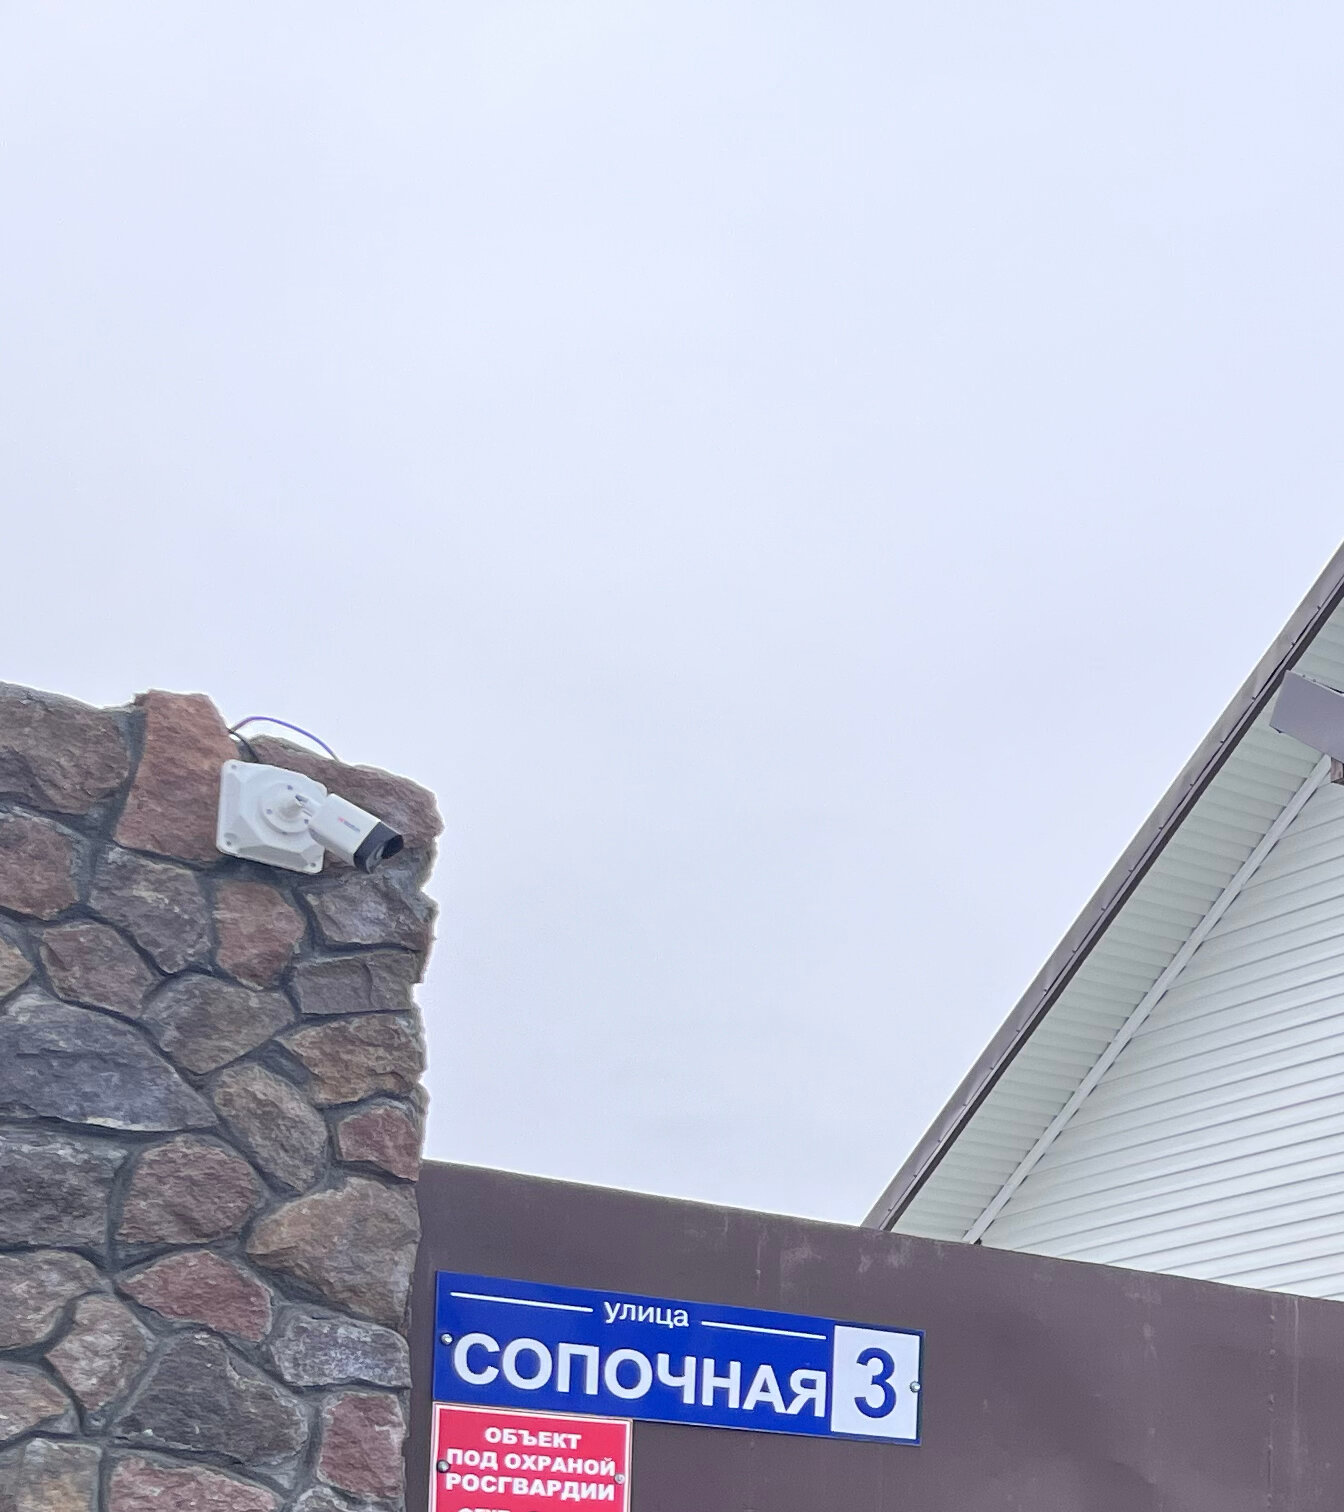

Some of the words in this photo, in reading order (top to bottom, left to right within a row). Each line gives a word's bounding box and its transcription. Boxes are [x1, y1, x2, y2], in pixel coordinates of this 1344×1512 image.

[603, 1300, 690, 1328] улица
[452, 1332, 828, 1418] СОПОЧНАЯ
[853, 1346, 898, 1419] 3
[484, 1426, 582, 1450] ОБЪЕКТ
[446, 1448, 499, 1471] ПОД
[503, 1453, 616, 1477] ОХРАНОЙ
[445, 1472, 616, 1502] РОСГВАРДИИ
